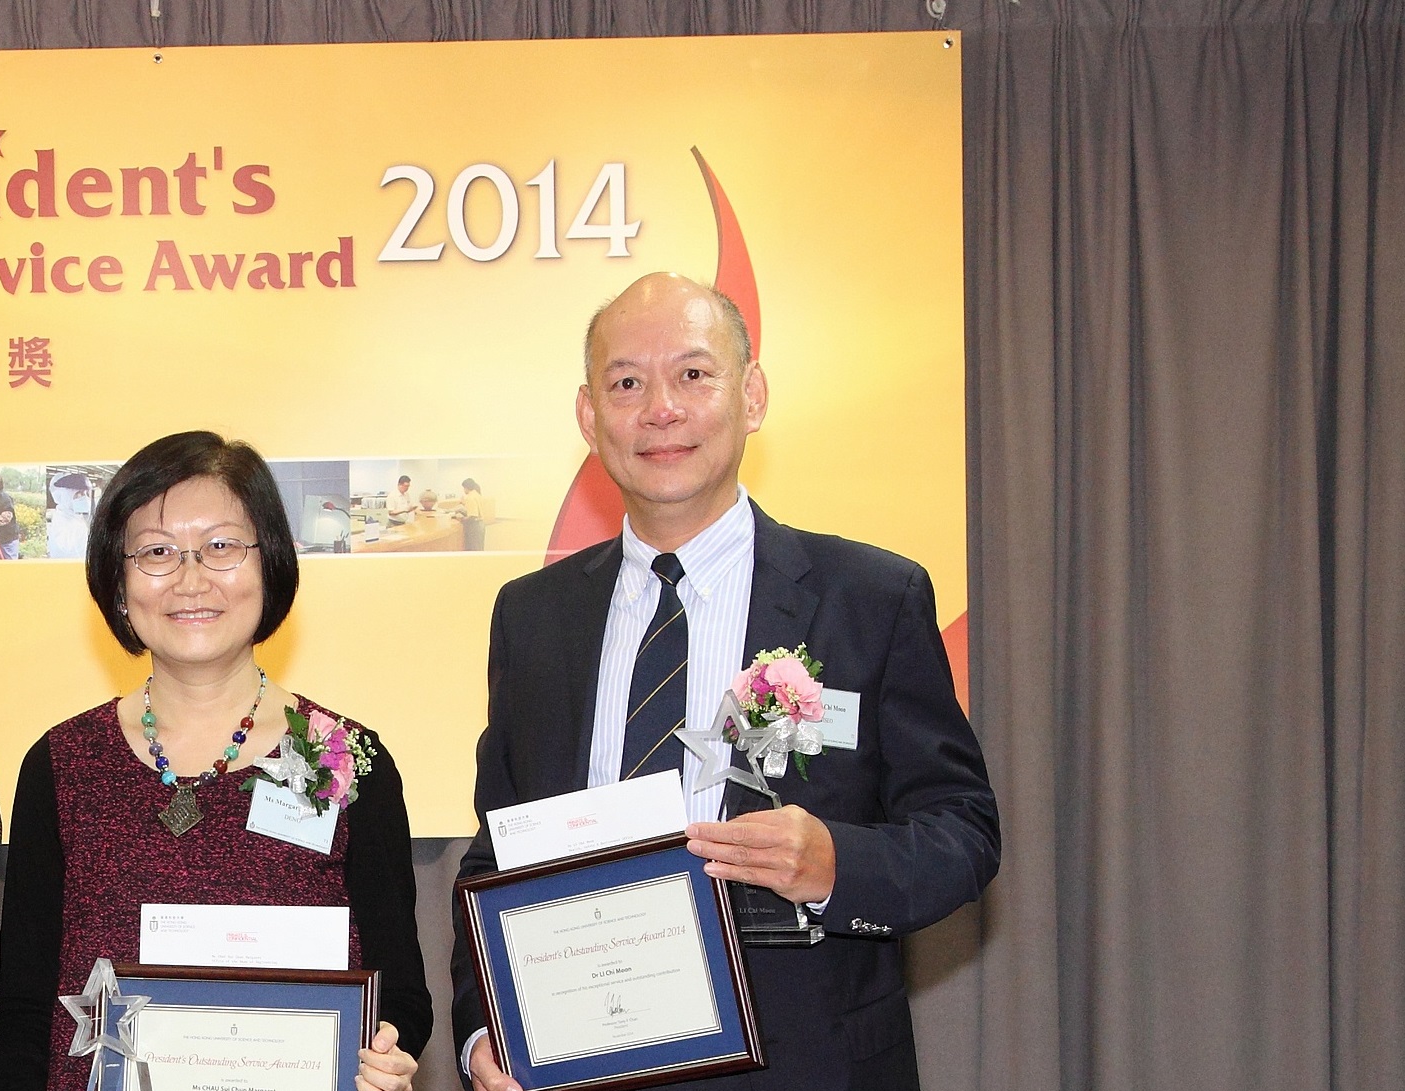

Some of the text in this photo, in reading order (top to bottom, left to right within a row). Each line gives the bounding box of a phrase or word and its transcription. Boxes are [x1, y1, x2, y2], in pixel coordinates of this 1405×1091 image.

[377, 157, 642, 262] 2014
[142, 236, 357, 291] Award
[523, 925, 686, 967] President's Outstanding Service Award 2014
[145, 1052, 321, 1070] President's Outstanding Service Award 2014
